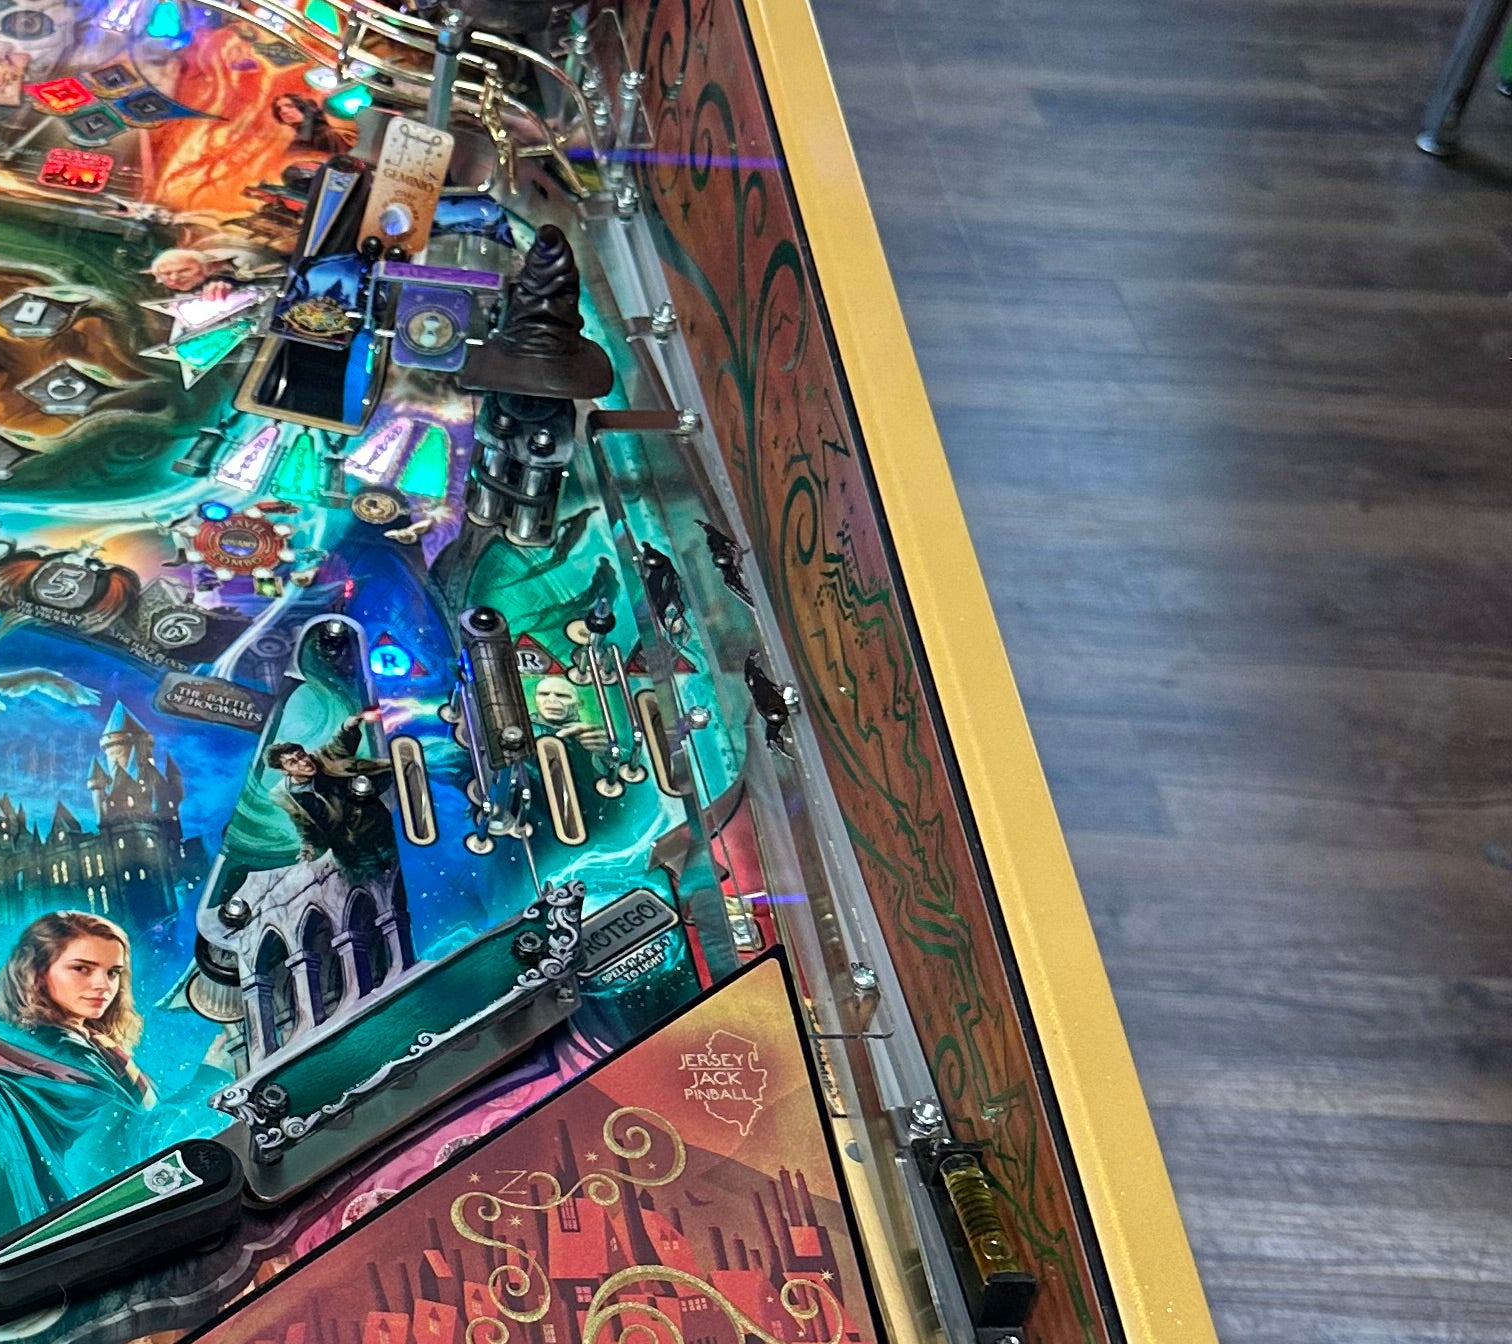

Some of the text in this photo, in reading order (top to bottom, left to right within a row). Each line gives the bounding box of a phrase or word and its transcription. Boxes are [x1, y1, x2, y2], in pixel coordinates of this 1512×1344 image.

[383, 167, 435, 194] GEMINIO
[217, 519, 266, 534] TRAVEL
[212, 552, 263, 567] COMBO
[40, 568, 86, 601] 5
[153, 612, 201, 646] 6
[518, 650, 544, 671] R
[166, 692, 263, 723] OF HOGWARTS
[178, 686, 257, 712] THE BATTLE
[581, 899, 663, 956] ROTEGO!
[601, 963, 627, 984] SPELL
[623, 968, 640, 982] TO
[678, 1053, 744, 1071] JERSEY
[690, 1071, 743, 1089] JACK
[683, 1088, 754, 1101] PINBALL
